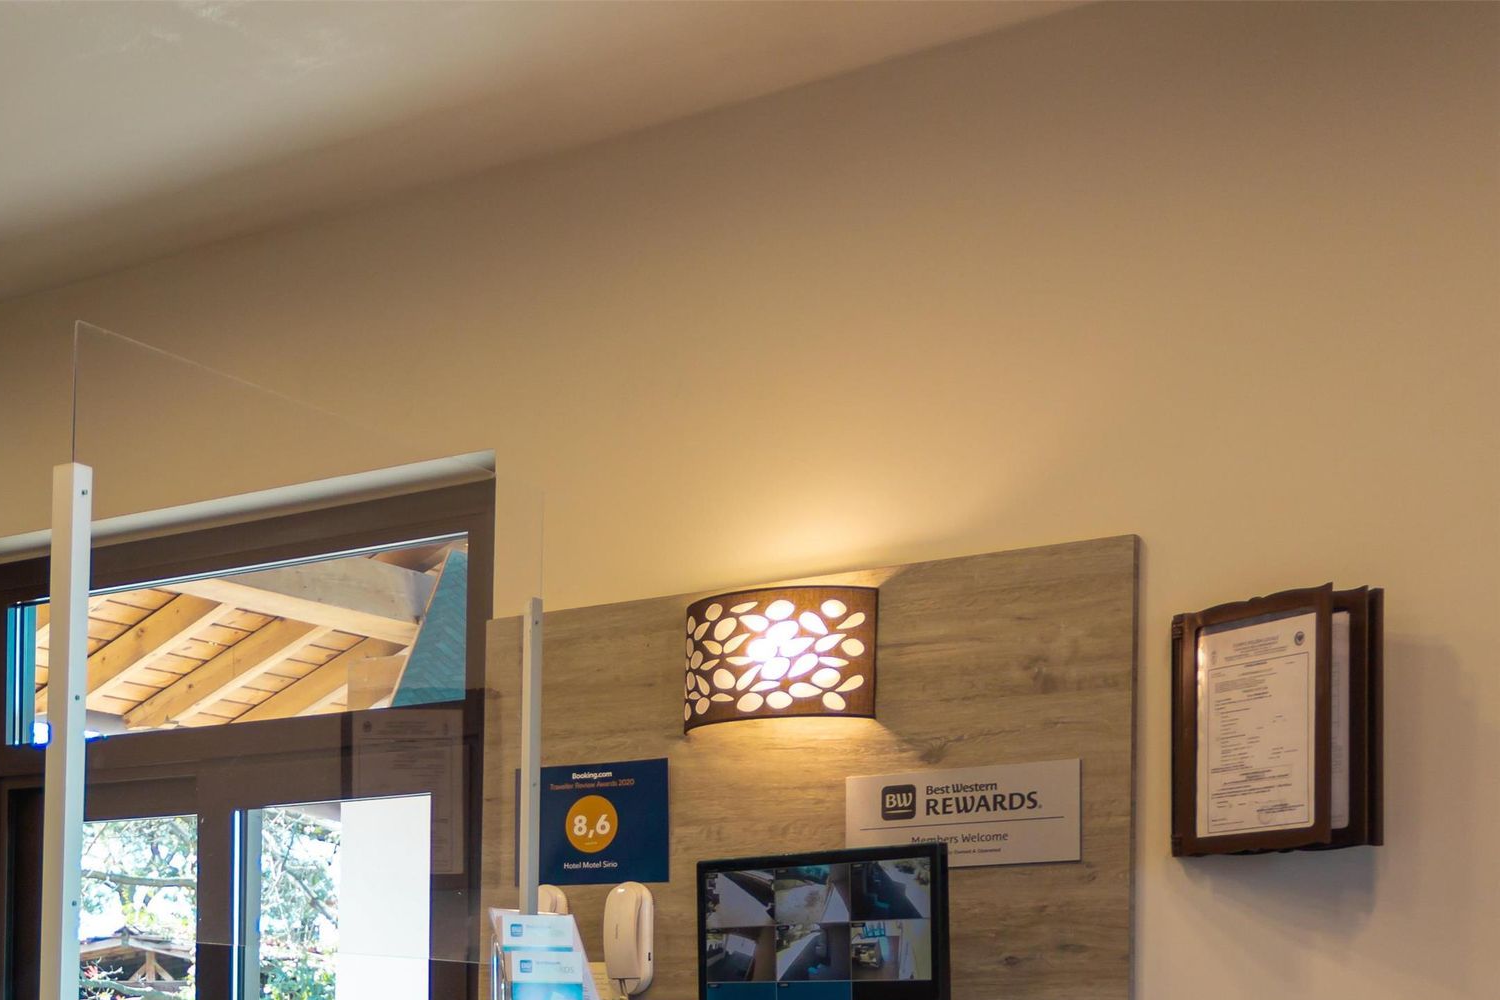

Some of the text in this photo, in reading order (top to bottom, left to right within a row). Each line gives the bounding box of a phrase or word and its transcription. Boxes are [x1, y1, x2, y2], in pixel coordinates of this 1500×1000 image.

[572, 771, 612, 780] Booking.com
[618, 778, 635, 786] 2020
[926, 783, 998, 795] Best Western
[885, 792, 913, 808] BW
[573, 814, 610, 838] 8,6
[961, 831, 1009, 843] Welcome
[563, 860, 618, 869] Hotel Motel Sirio
